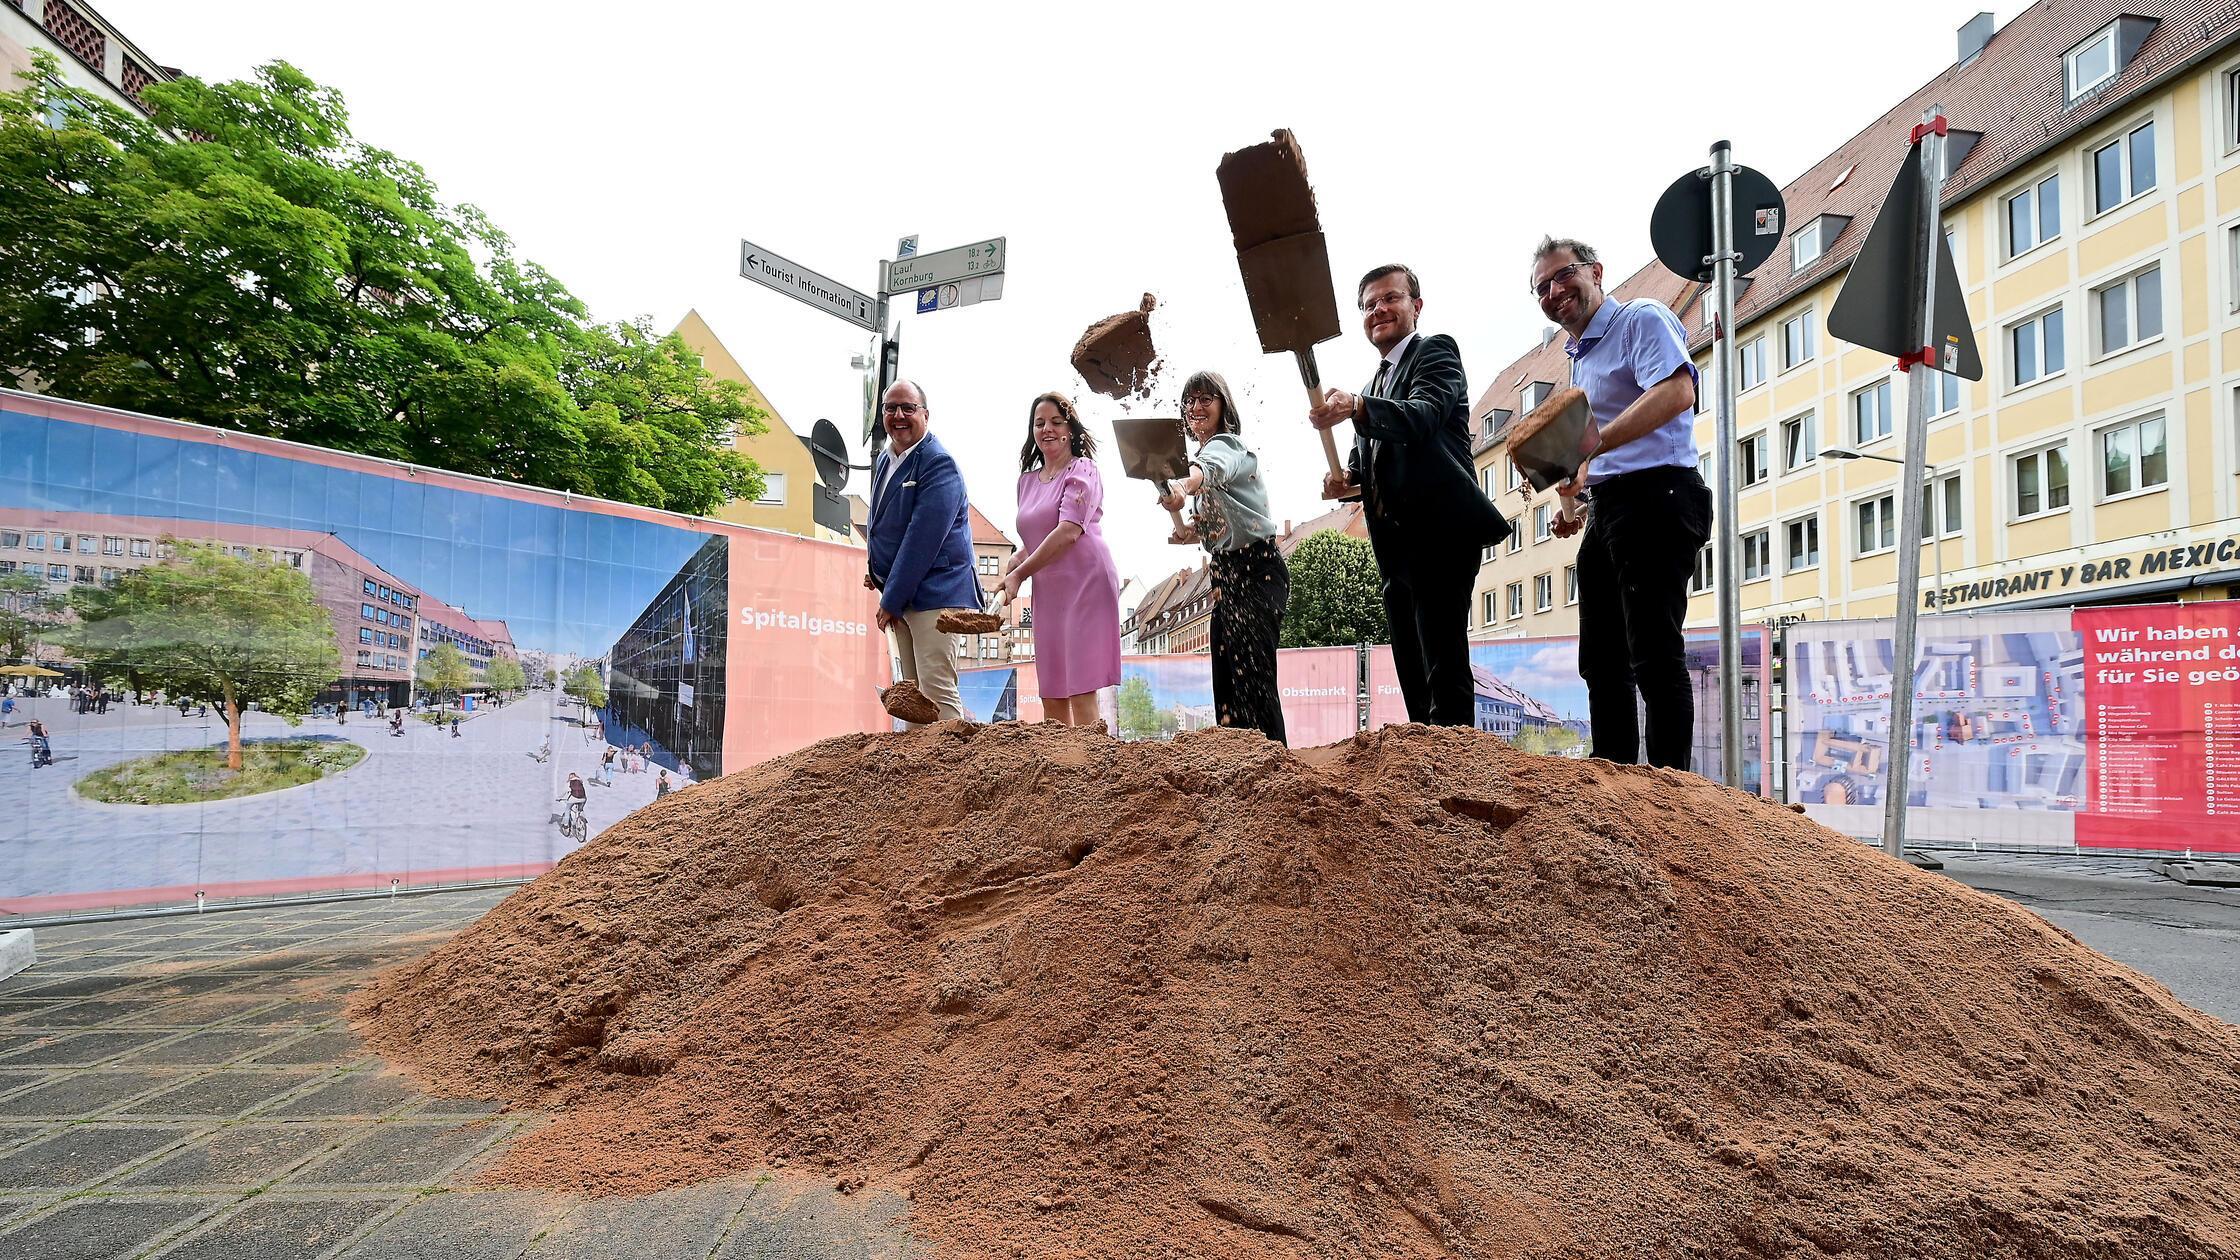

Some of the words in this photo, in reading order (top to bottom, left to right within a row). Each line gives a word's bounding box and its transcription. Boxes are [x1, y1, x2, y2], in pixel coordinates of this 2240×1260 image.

[894, 262, 913, 276] Lauf
[760, 258, 794, 285] Tourist
[798, 275, 852, 310] Information
[893, 271, 934, 288] Kornburg
[1924, 570, 2053, 608] RESTAURANT
[2060, 565, 2075, 587] Y
[2080, 557, 2131, 584] BAR
[2139, 538, 2240, 575] MEXIC
[740, 605, 868, 637] Spitalgasse
[2095, 627, 2140, 643] Wir
[2146, 625, 2229, 641] haben
[2095, 644, 2210, 664] während
[2218, 644, 2240, 660] d
[2096, 668, 2136, 684] für
[2142, 667, 2180, 683] Sie
[1282, 685, 1347, 697] Obstmarkt
